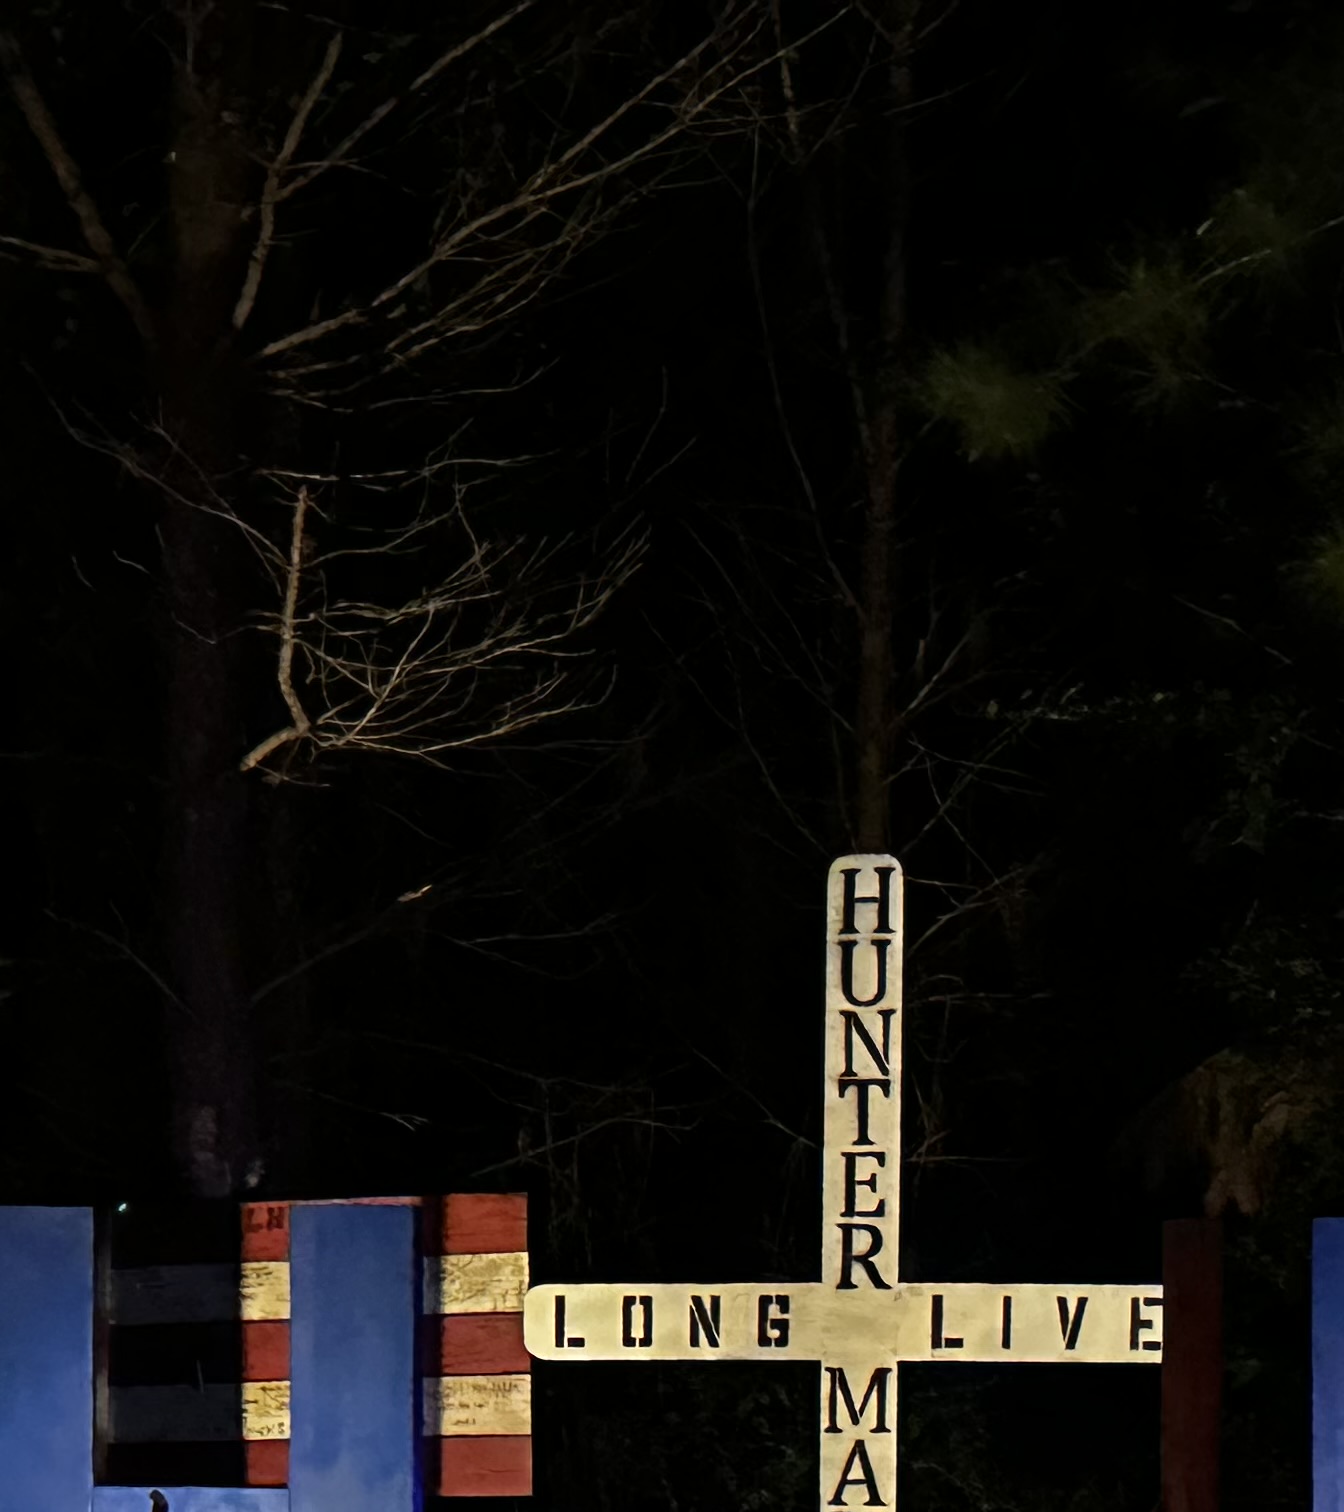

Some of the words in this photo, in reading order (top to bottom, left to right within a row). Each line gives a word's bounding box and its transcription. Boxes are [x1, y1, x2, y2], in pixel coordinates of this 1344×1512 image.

[836, 867, 897, 1290] HUNTER
[555, 1294, 790, 1349] LONG
[931, 1294, 1163, 1351] LIVE
